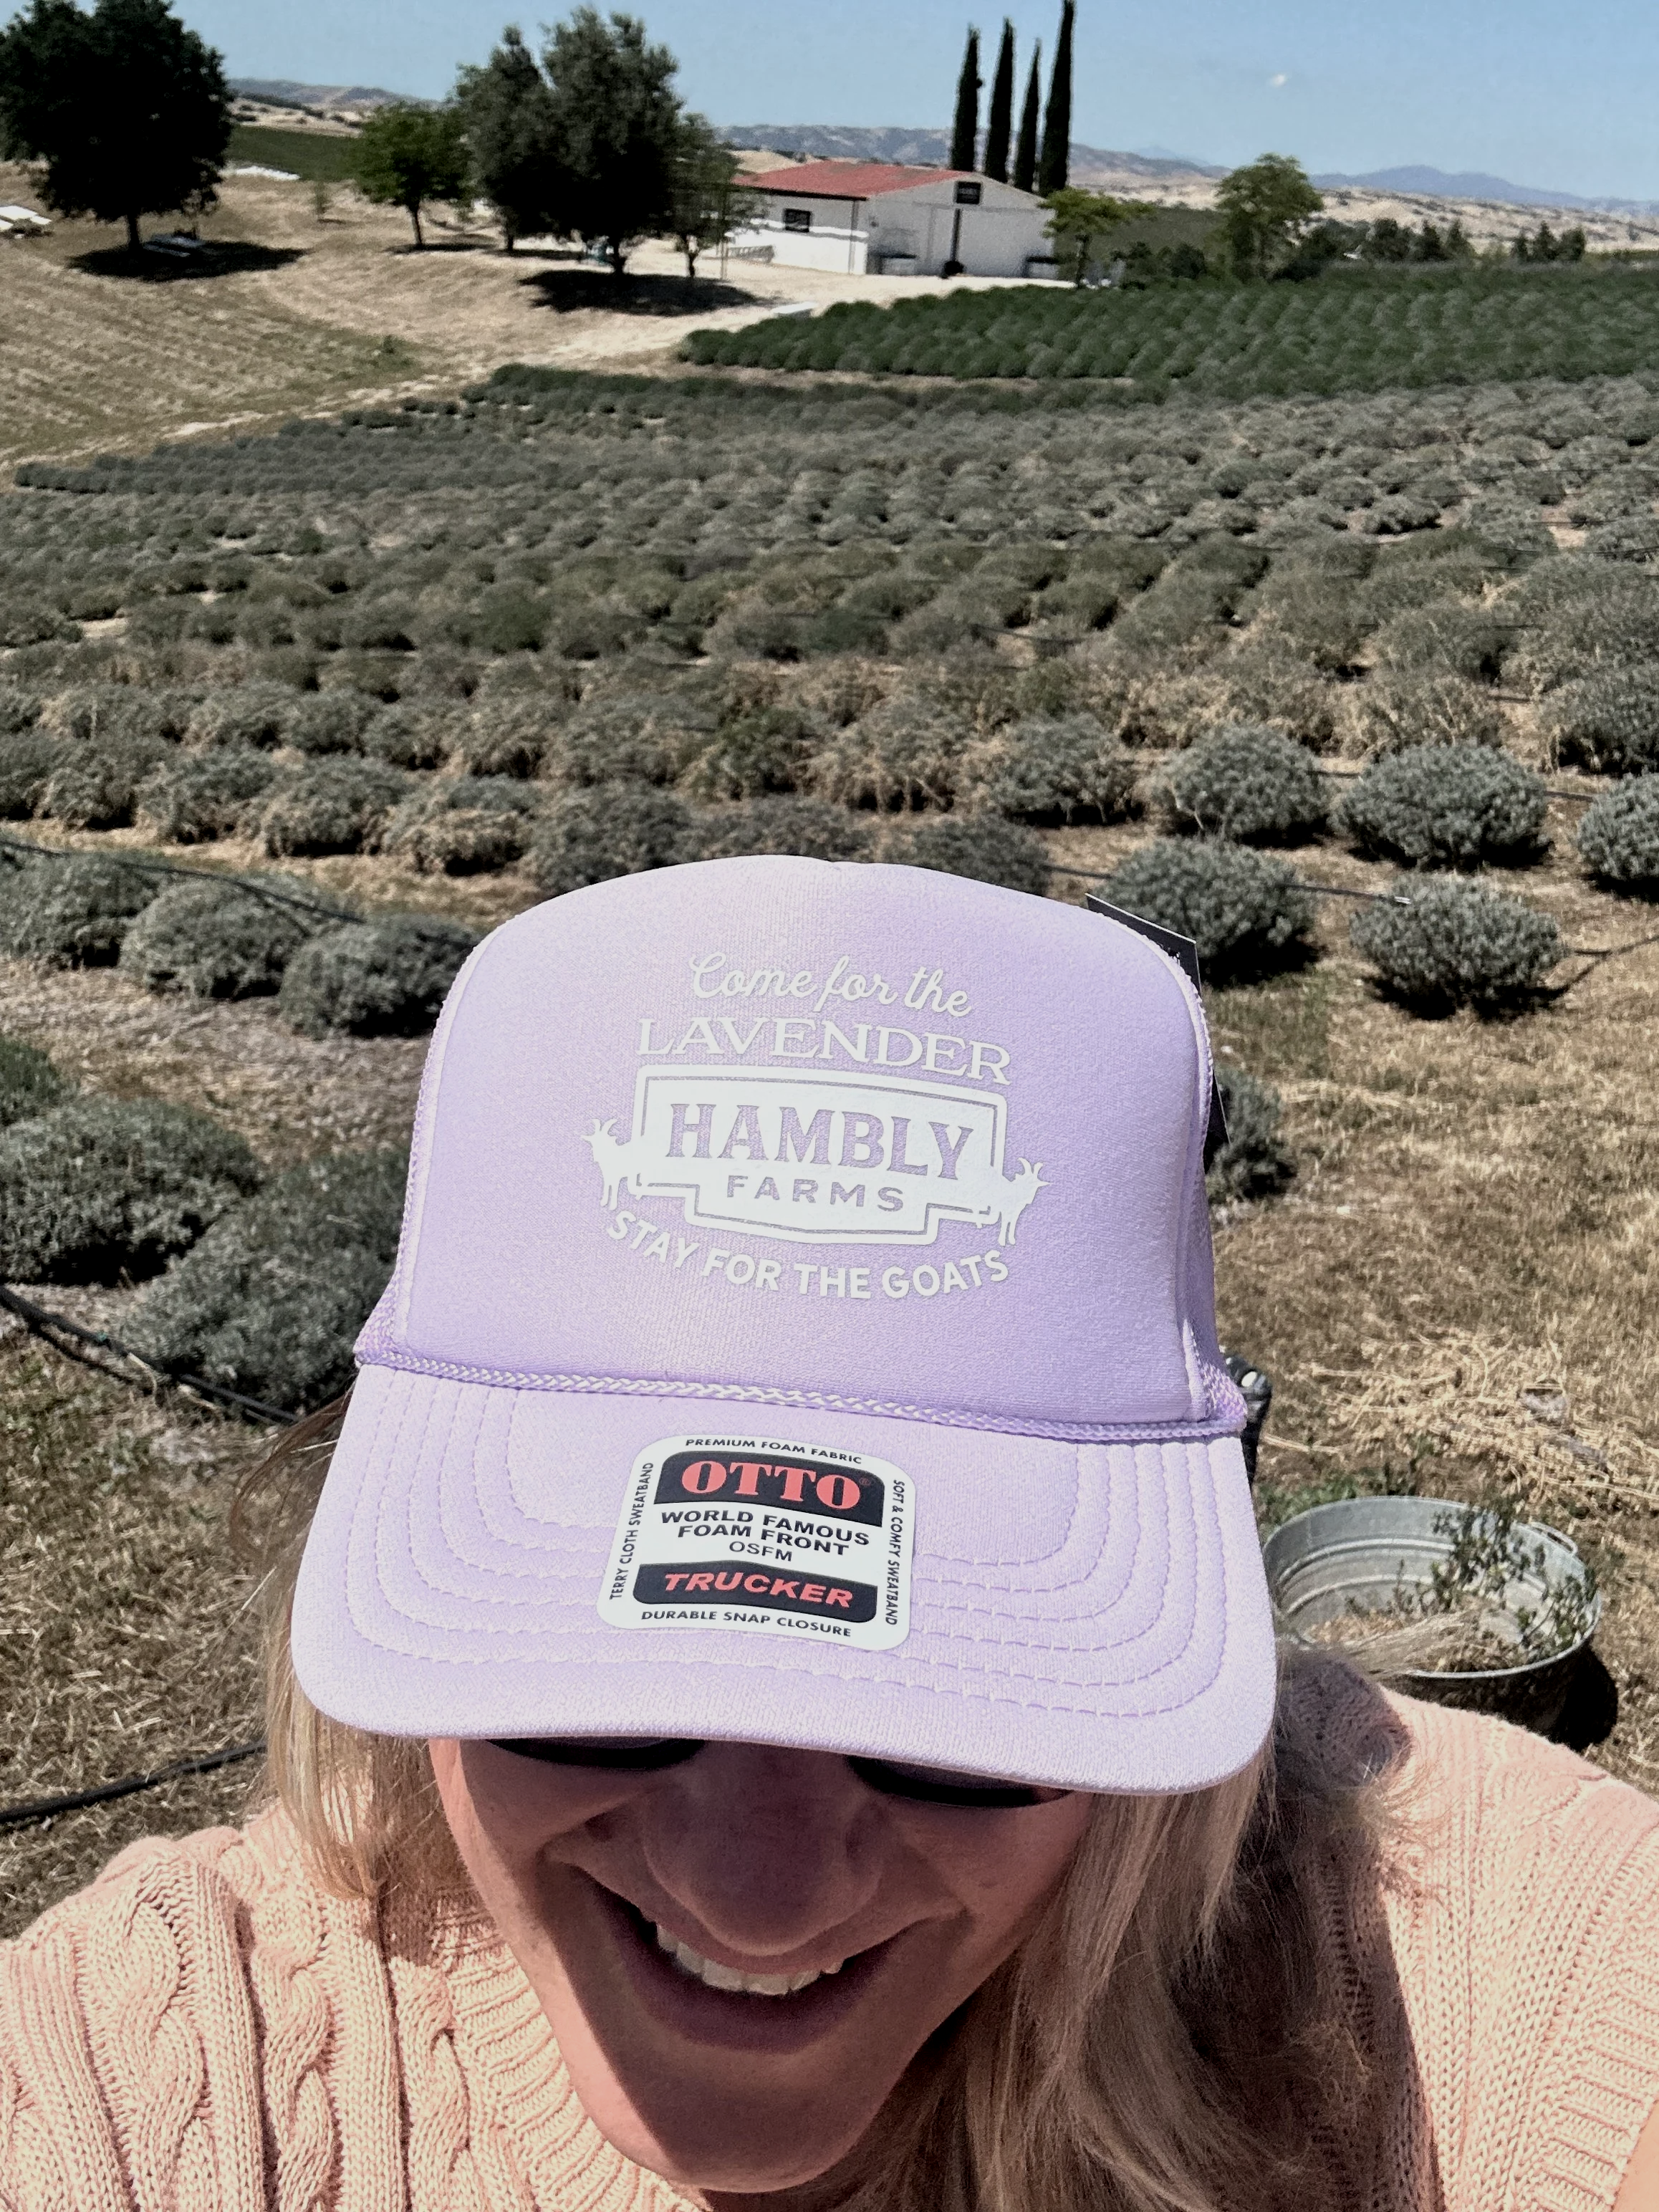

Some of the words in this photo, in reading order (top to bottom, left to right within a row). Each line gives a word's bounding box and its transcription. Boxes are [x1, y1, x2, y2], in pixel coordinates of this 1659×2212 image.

[689, 951, 817, 999] Come
[812, 955, 901, 1013] for
[903, 966, 973, 1018] the
[635, 1016, 1012, 1085] LAVENDER
[665, 1103, 975, 1180] HAMBLY
[726, 1175, 905, 1213] FARMS
[606, 1210, 701, 1271] STAY
[701, 1249, 782, 1292] FOR
[793, 1263, 872, 1299] THE
[881, 1249, 1009, 1299] GOATS
[685, 1438, 756, 1448] PREMIUM
[761, 1441, 807, 1455] FOAM
[810, 1447, 862, 1465] FABRIC
[628, 1462, 654, 1526] SWEATBAND
[681, 1460, 861, 1511] OTTO
[893, 1479, 905, 1504] SOFT
[660, 1509, 754, 1525] WORLD
[763, 1514, 870, 1546] FAMOUS
[678, 1524, 751, 1539] FOAM
[760, 1529, 850, 1556] FRONT
[888, 1516, 903, 1558] COMFY
[619, 1529, 639, 1564] CLOTH
[728, 1540, 793, 1562] OSFM
[610, 1567, 630, 1601] TERRY
[664, 1571, 854, 1608] TRUCKER
[885, 1559, 900, 1625] SWEATBAND
[641, 1610, 718, 1620] DURABLE
[722, 1610, 771, 1625] SNAP
[776, 1617, 852, 1638] CLOSURE
